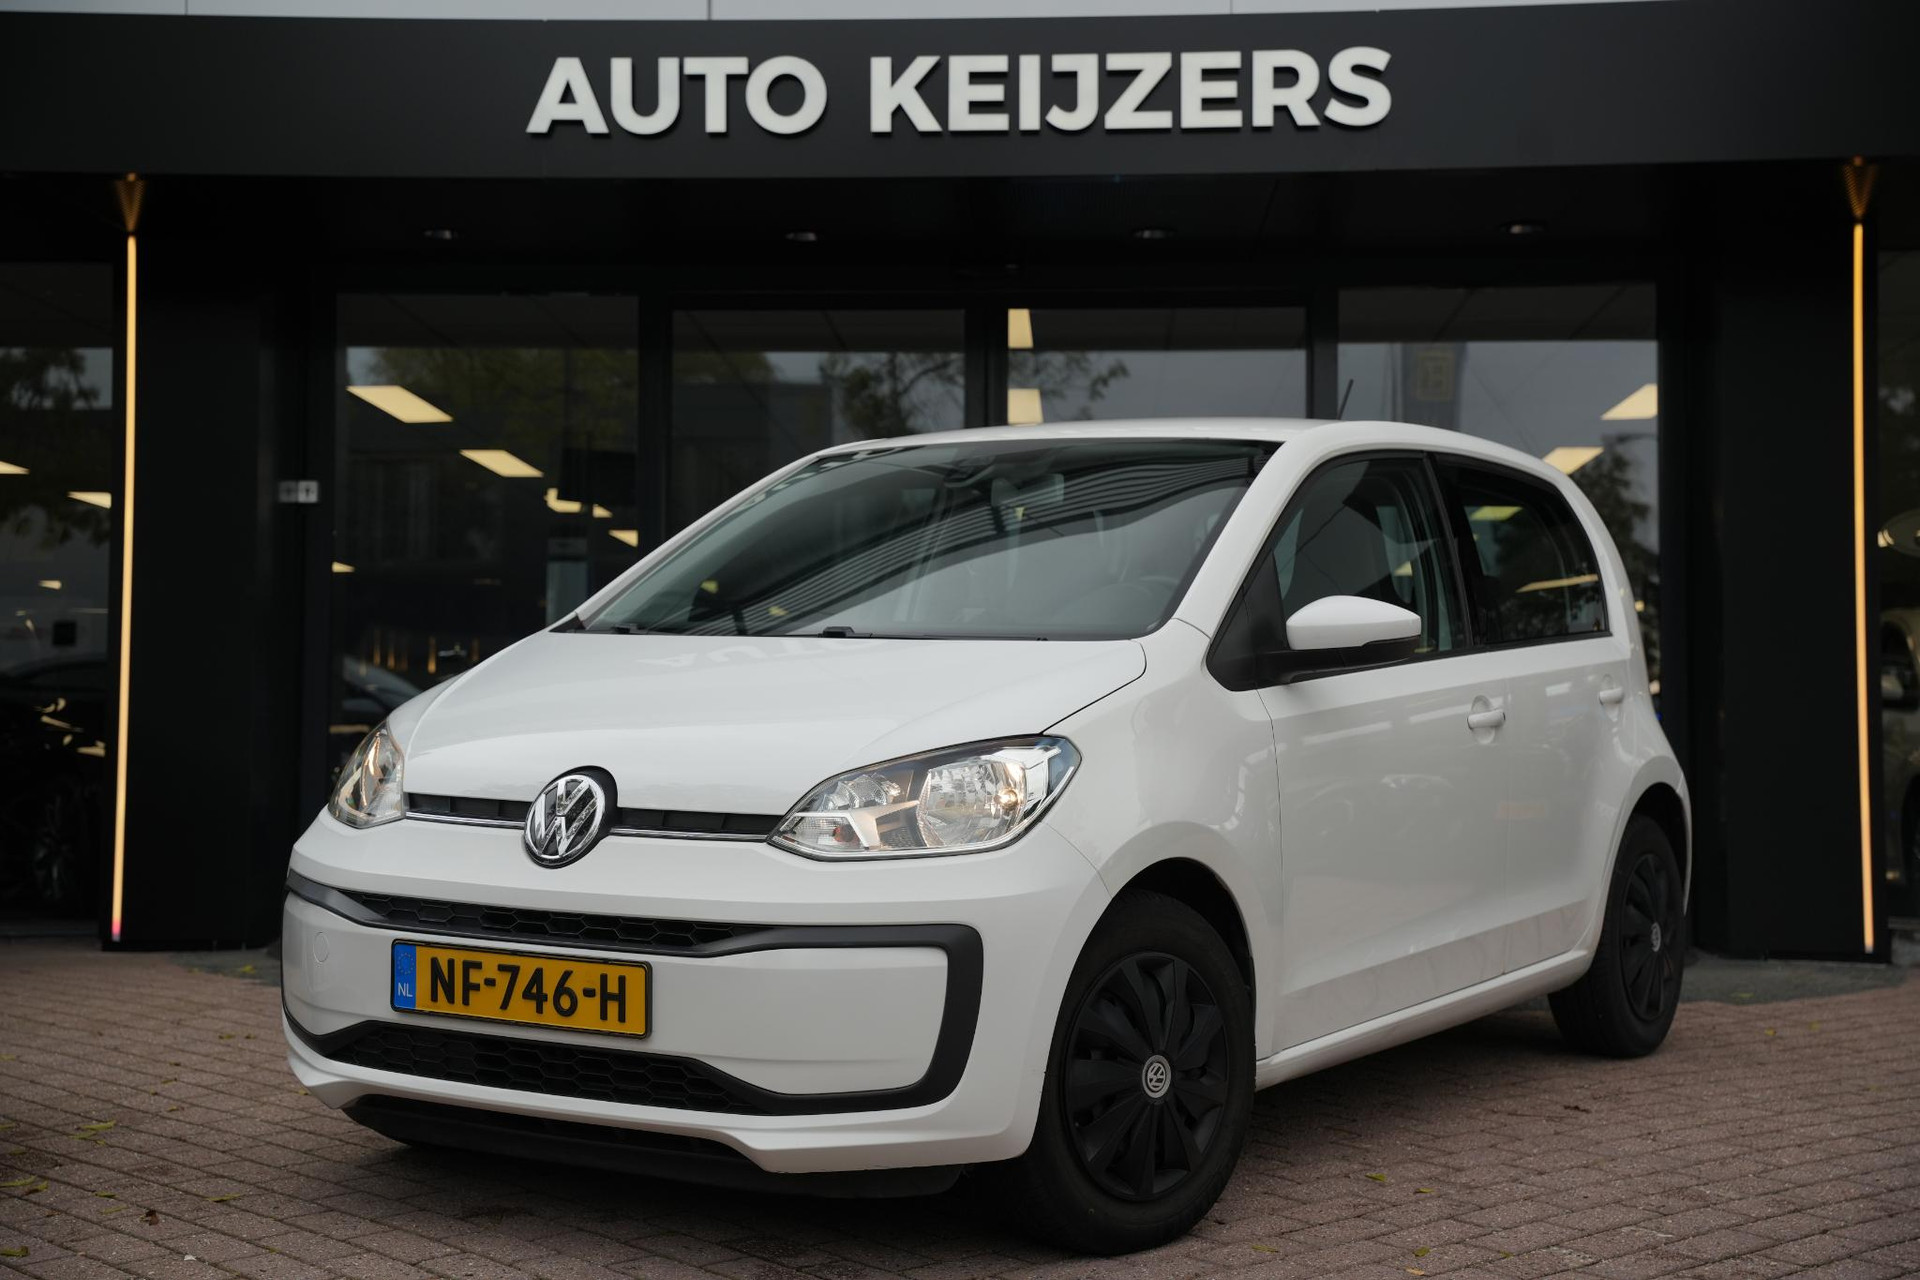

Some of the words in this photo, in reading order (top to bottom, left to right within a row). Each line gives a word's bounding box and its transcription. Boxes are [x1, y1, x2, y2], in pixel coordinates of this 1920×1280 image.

[526, 55, 828, 136] AUTO
[869, 46, 1393, 134] KEIJZERS
[397, 982, 413, 998] NL
[430, 956, 626, 1024] NF-746-H
